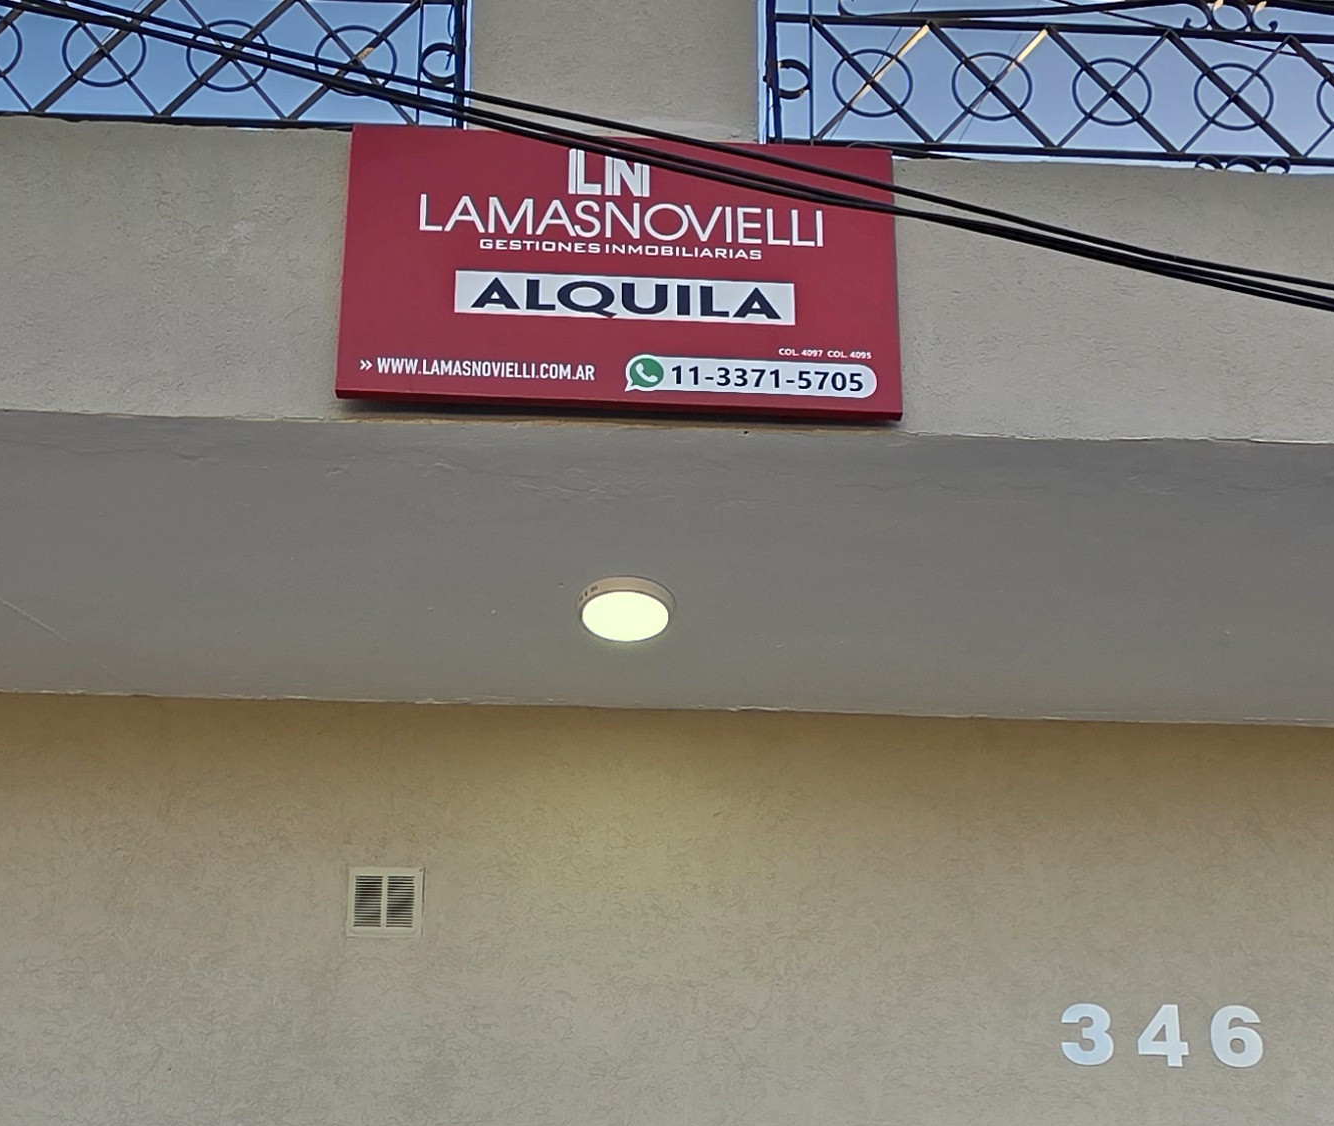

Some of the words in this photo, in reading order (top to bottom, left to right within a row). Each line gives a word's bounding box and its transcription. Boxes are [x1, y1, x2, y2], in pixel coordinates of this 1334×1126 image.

[568, 147, 650, 198] LN
[418, 193, 824, 248] LAMASNOVIELLI
[479, 238, 601, 254] GESTIONES
[605, 244, 762, 260] INMOBILIARIAS
[469, 277, 782, 320] ALQUILA
[376, 357, 595, 381] WWW.LAMASNOVIELLI.COM.AR
[671, 365, 864, 392] 11-3371-5705
[1061, 1003, 1264, 1068] 346
